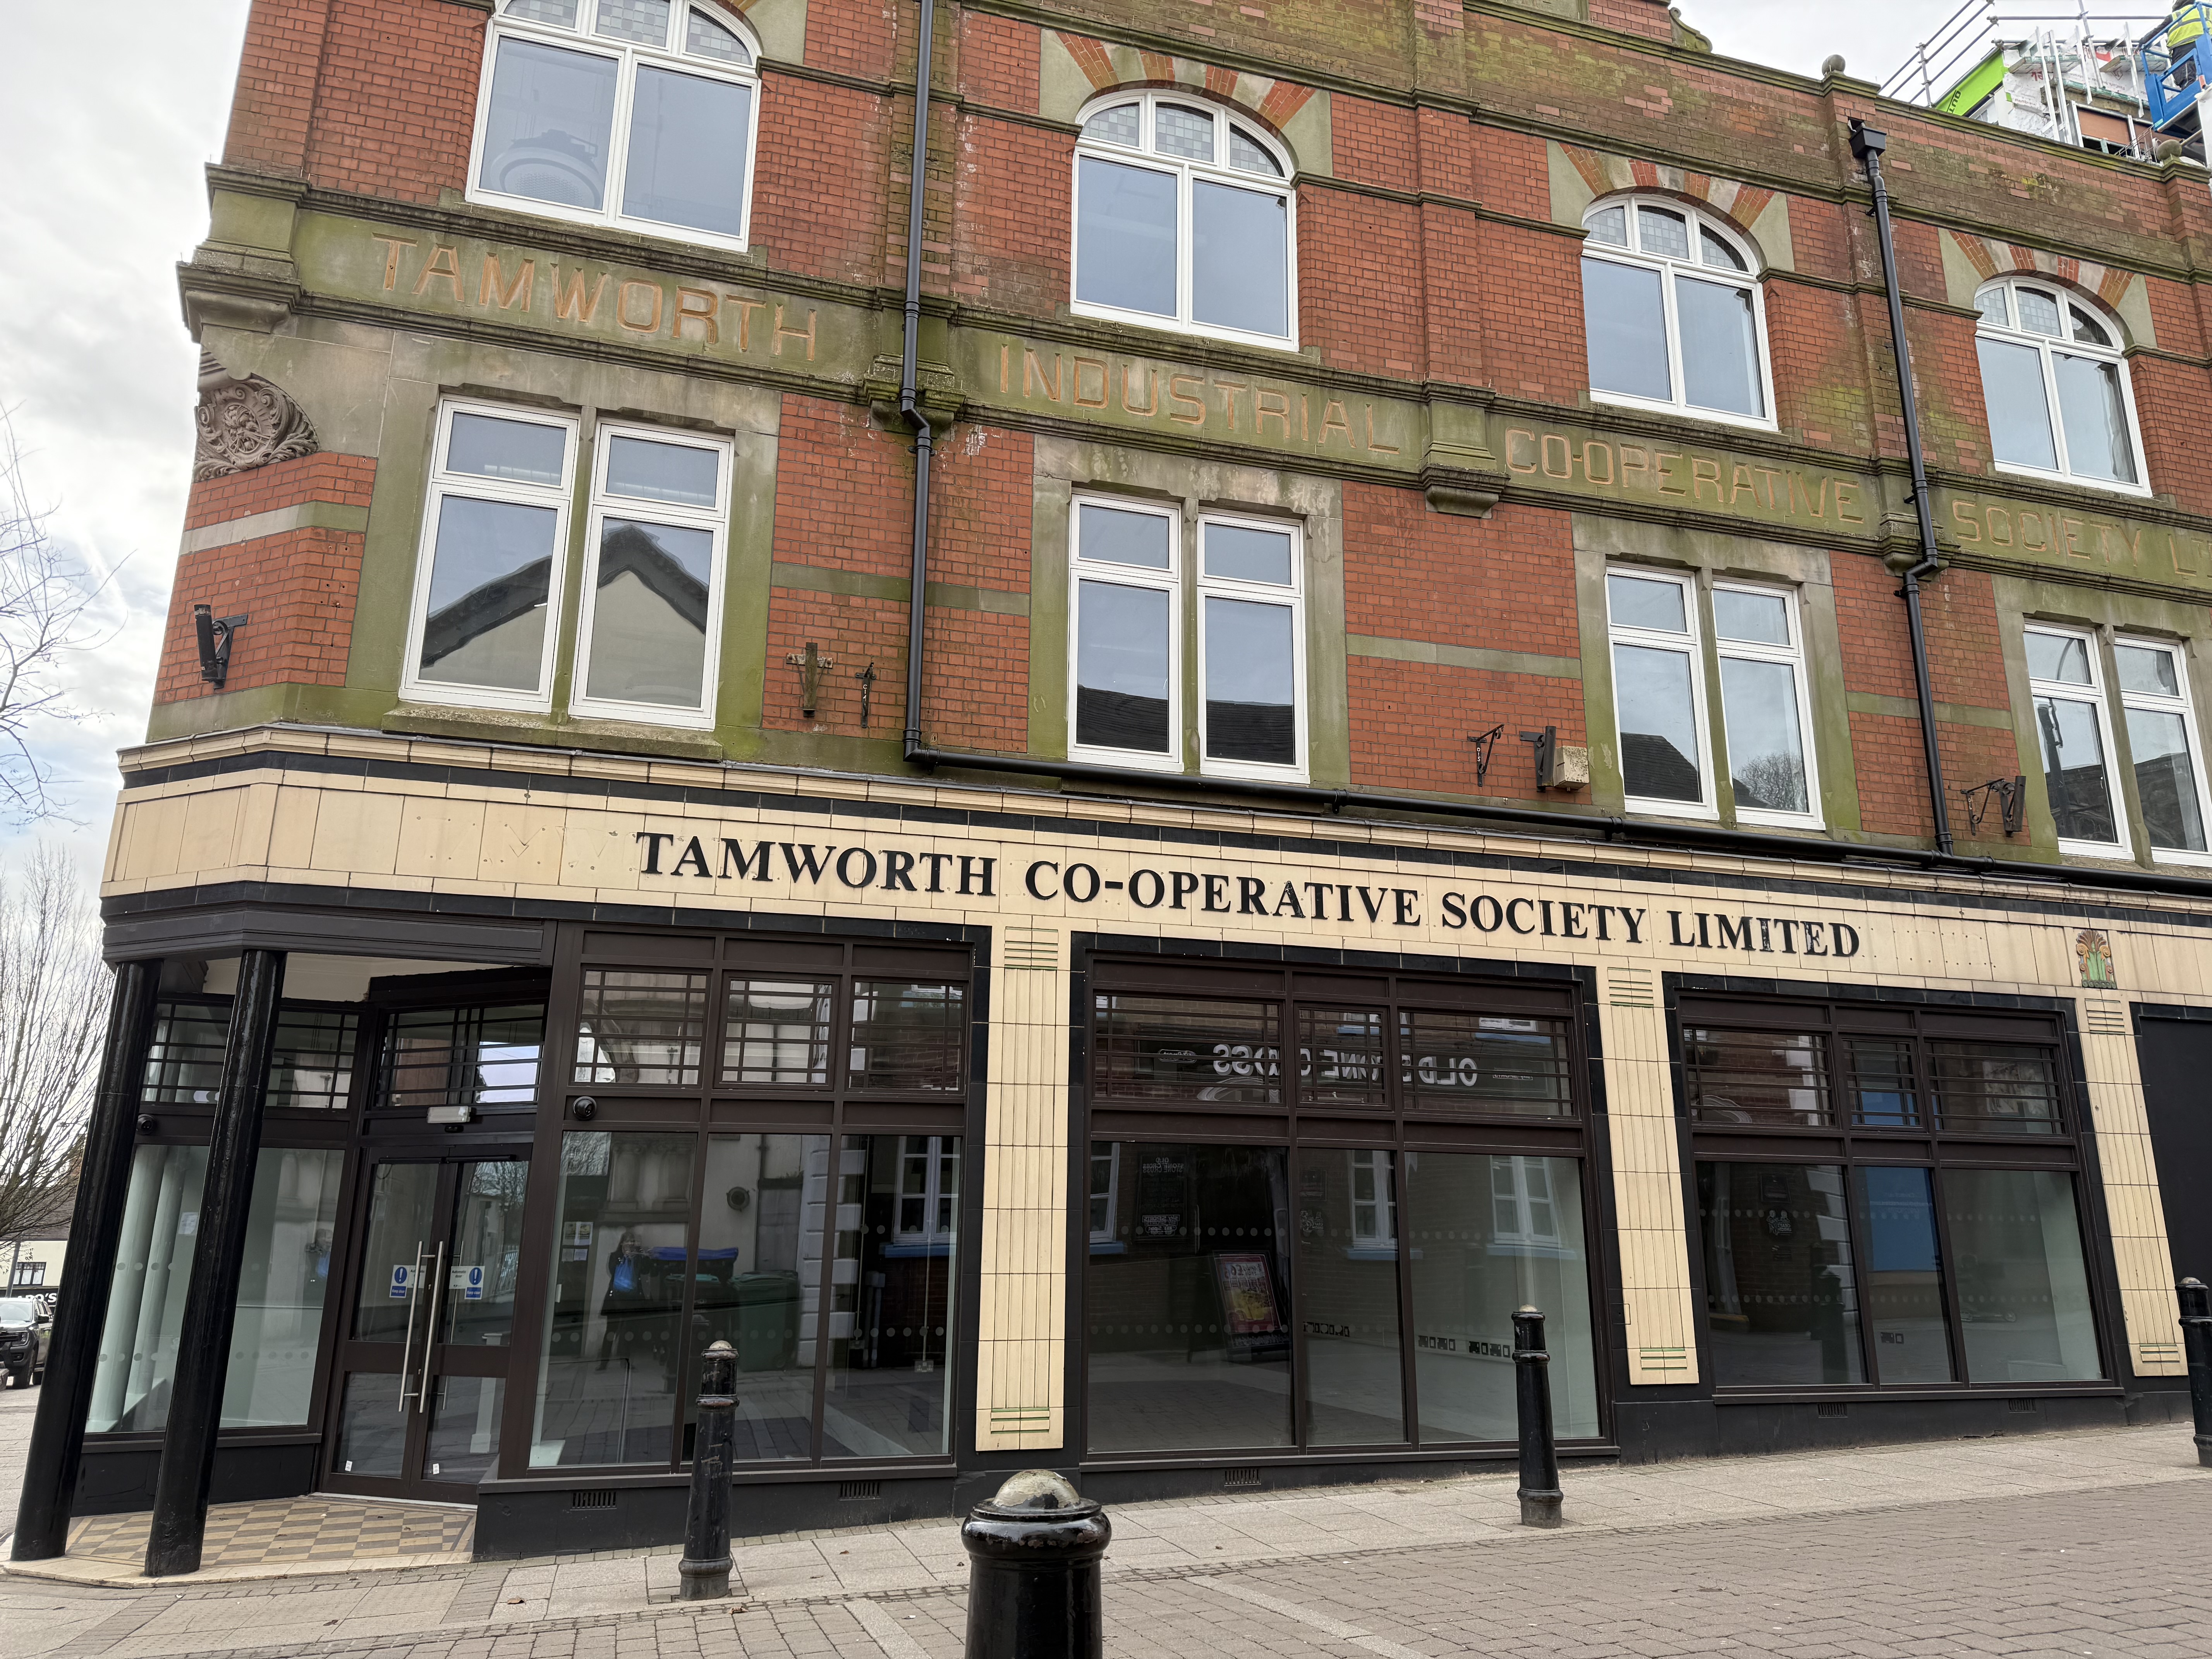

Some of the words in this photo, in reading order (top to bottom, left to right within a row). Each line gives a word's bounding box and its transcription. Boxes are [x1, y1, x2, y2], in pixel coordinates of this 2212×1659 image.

[371, 232, 817, 361] TAMWORTH
[1000, 343, 1400, 455] INDUSTRIAL
[1505, 424, 1864, 524] CO-OPERATIVE
[1951, 498, 2141, 567] SOCIETY
[636, 832, 997, 898] TAMWORTH
[1026, 861, 1420, 927] CO-OPERATIVE
[1441, 892, 1647, 944] SOCIETY
[1667, 910, 1860, 958] LIMITED
